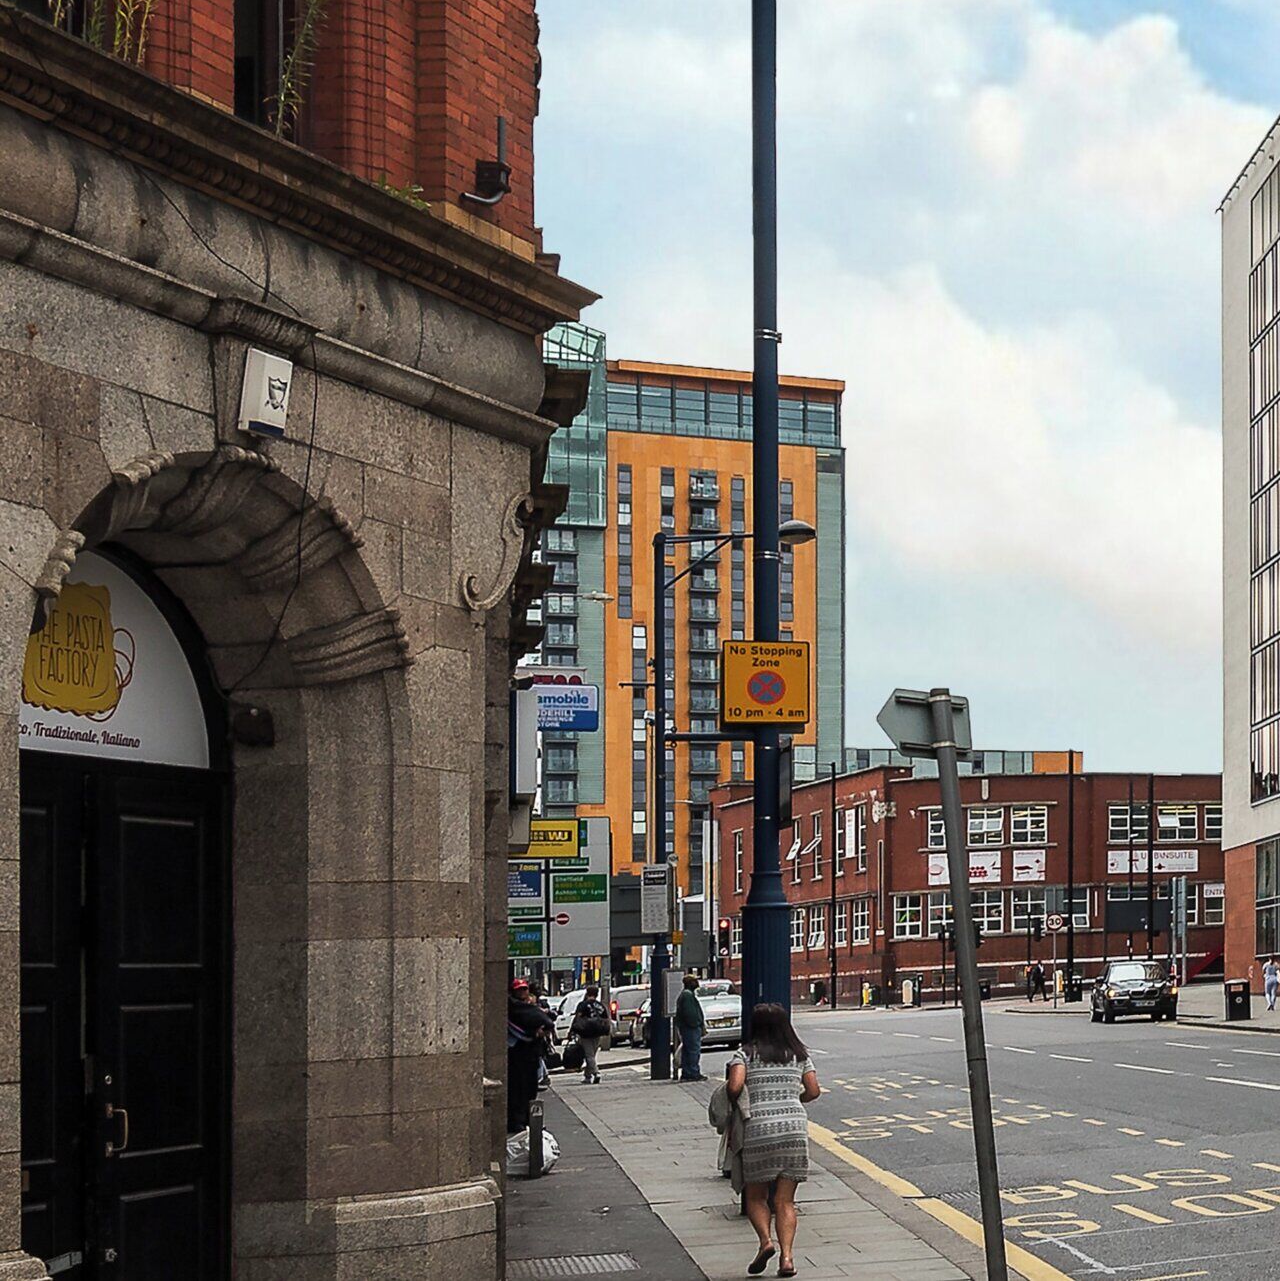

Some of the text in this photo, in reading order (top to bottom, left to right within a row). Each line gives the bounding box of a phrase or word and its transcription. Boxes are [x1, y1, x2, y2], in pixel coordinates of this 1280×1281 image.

[66, 612, 105, 653] PASTA
[729, 645, 803, 658] No Stopping
[39, 645, 99, 688] FACTORY
[752, 658, 780, 668] Zone
[729, 707, 742, 717] 10
[746, 709, 764, 719] pm
[776, 708, 784, 717] 4
[33, 721, 100, 746] Tradizionale,
[101, 730, 141, 749] Italiano
[1140, 850, 1195, 860] UBANSUITE
[1048, 918, 1060, 926] 30
[999, 1168, 1234, 1205] BUS
